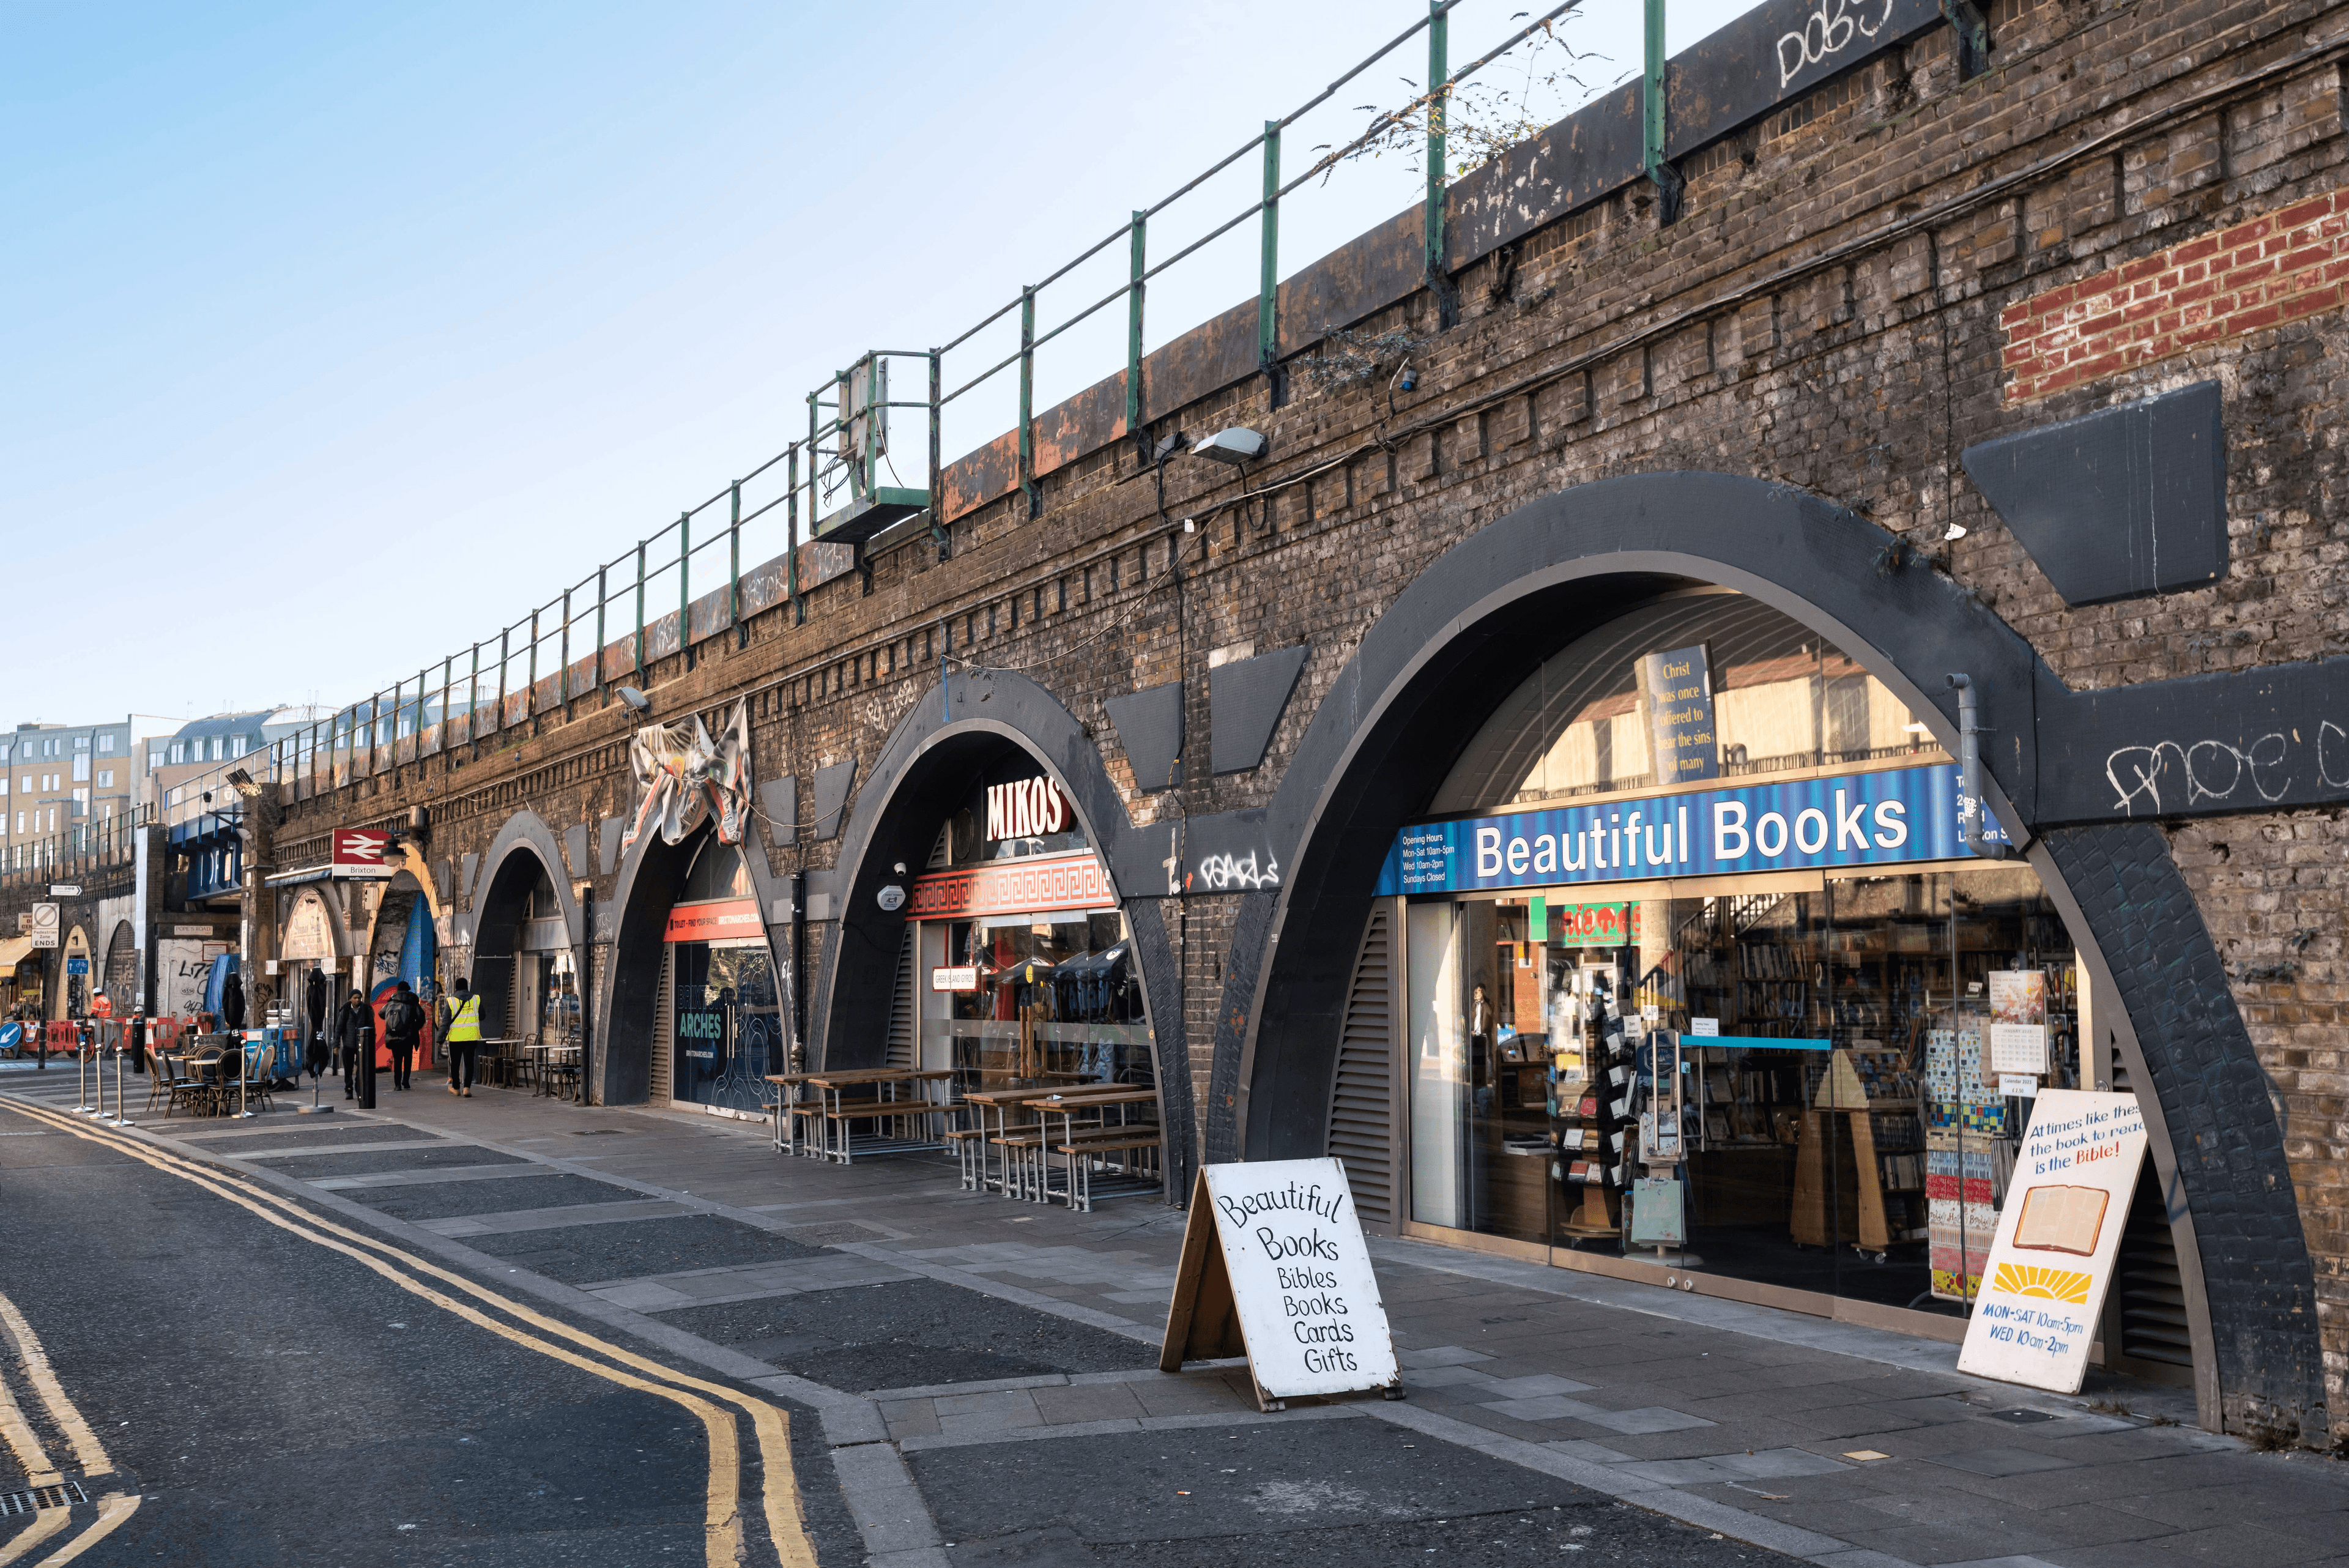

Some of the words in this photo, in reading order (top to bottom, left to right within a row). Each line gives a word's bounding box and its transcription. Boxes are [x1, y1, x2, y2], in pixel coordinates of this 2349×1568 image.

[1663, 661, 1690, 679] Christ
[1659, 691, 1675, 704] was
[1678, 686, 1699, 700] once
[1660, 707, 1691, 727] offered
[1693, 707, 1703, 721] to
[1657, 735, 1675, 750] bear
[1678, 732, 1691, 748] the
[1694, 729, 1711, 745] sins
[1669, 756, 1678, 772] of
[1680, 757, 1704, 773] many
[987, 776, 1062, 842] MIKOS
[1403, 836, 1425, 846] Opening
[1427, 834, 1442, 842] Hours
[1476, 806, 1687, 879] Beautiful
[1714, 789, 1908, 860] Books
[1403, 848, 1425, 857] Mon-Sat
[1427, 845, 1454, 855] 10am-5pm
[1417, 860, 1444, 869] 10am-2pm
[1404, 874, 1425, 884] Sundays
[1427, 872, 1445, 881] Closed
[961, 974, 973, 983] GYROS
[678, 985, 723, 1010] BRIXTON
[680, 1013, 721, 1039] ARCHES
[686, 1050, 713, 1058] BRIXTONARCHES.COM
[2029, 1124, 2044, 1140] At
[2046, 1118, 2082, 1135] times
[2086, 1111, 2109, 1125] like
[2113, 1105, 2140, 1118] thes
[2030, 1143, 2052, 1157] the
[2056, 1132, 2088, 1150] book
[2093, 1130, 2105, 1141] to
[2035, 1161, 2045, 1175] is
[2049, 1156, 2071, 1171] the
[2076, 1141, 2119, 1165] Bible!
[1217, 1181, 1343, 1228] Beautiful
[1256, 1227, 1339, 1260] Books
[1277, 1266, 1337, 1289] Bibles
[1283, 1291, 1348, 1317] Books
[1294, 1318, 1354, 1344] Cards
[1983, 1303, 2036, 1324] MON-SAT
[2037, 1312, 2084, 1337] 10am-5pm
[1990, 1324, 2014, 1342] WED
[1304, 1345, 1357, 1373] Gifts
